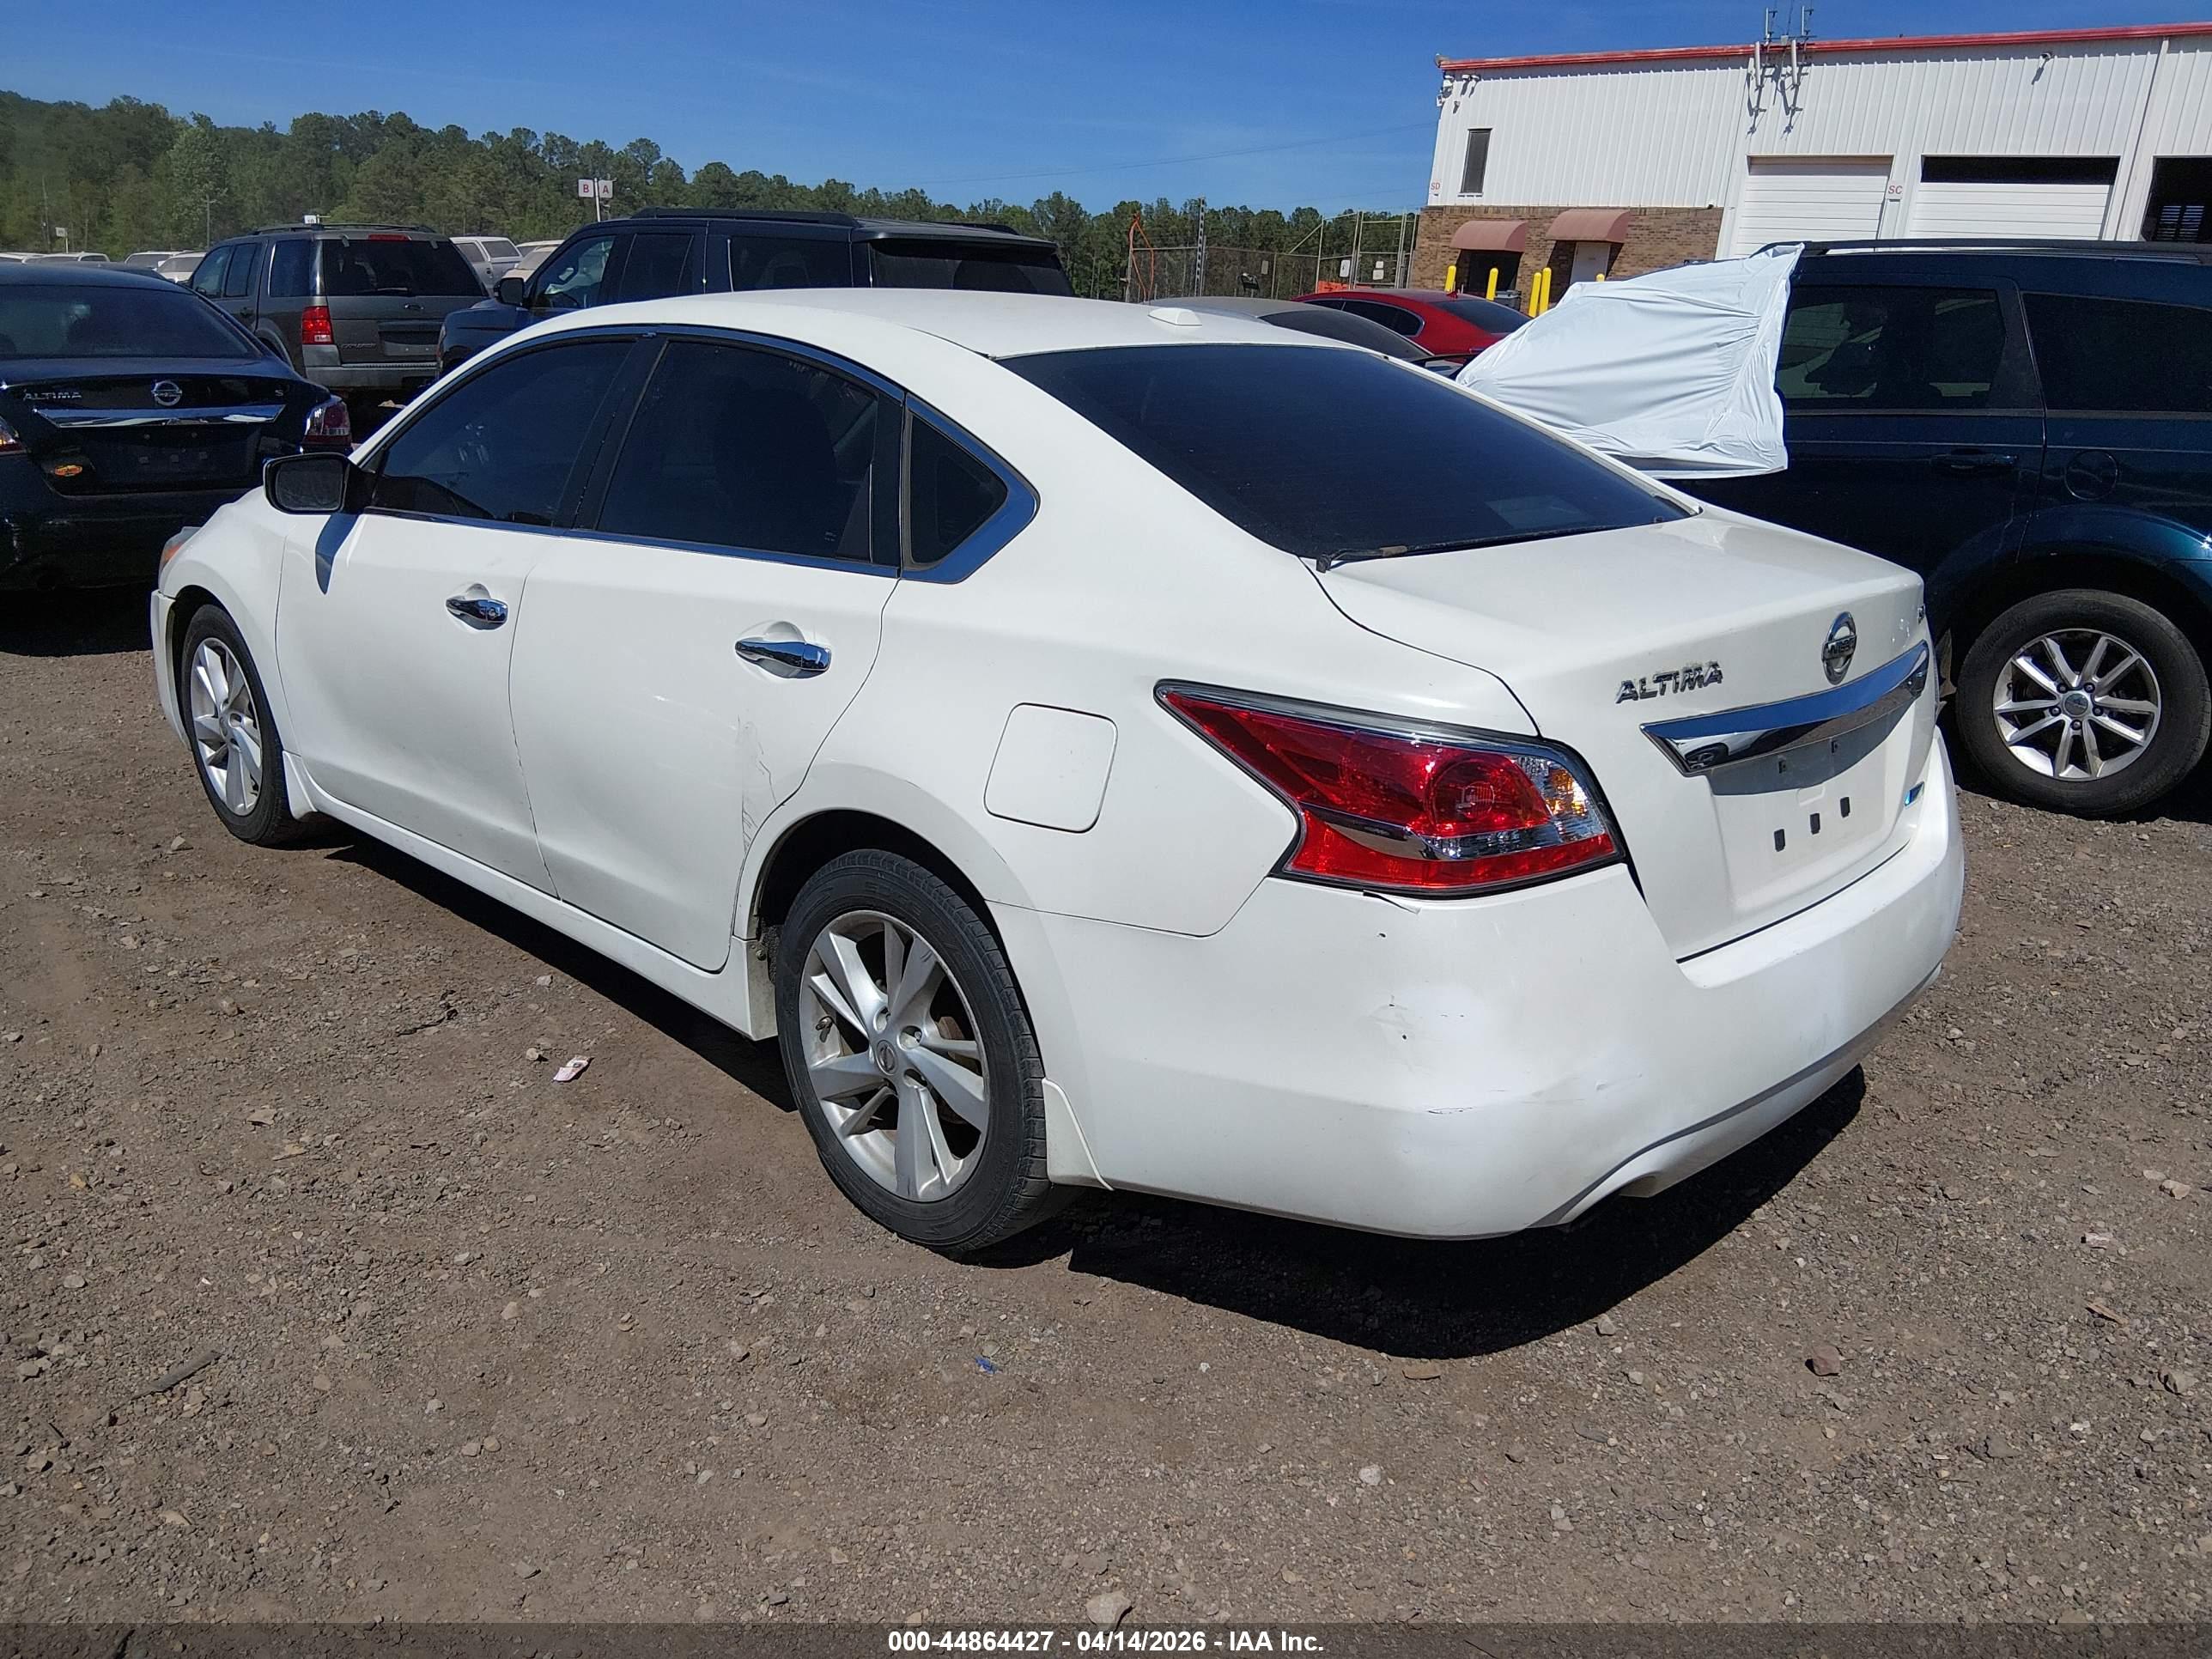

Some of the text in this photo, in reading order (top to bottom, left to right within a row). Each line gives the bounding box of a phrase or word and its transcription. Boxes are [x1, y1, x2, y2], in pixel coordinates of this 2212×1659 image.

[583, 184, 590, 193] B
[603, 185, 610, 194] A
[1888, 185, 1903, 194] SC
[22, 389, 82, 401] ALTIMA
[1615, 660, 1723, 704] ALTIMA
